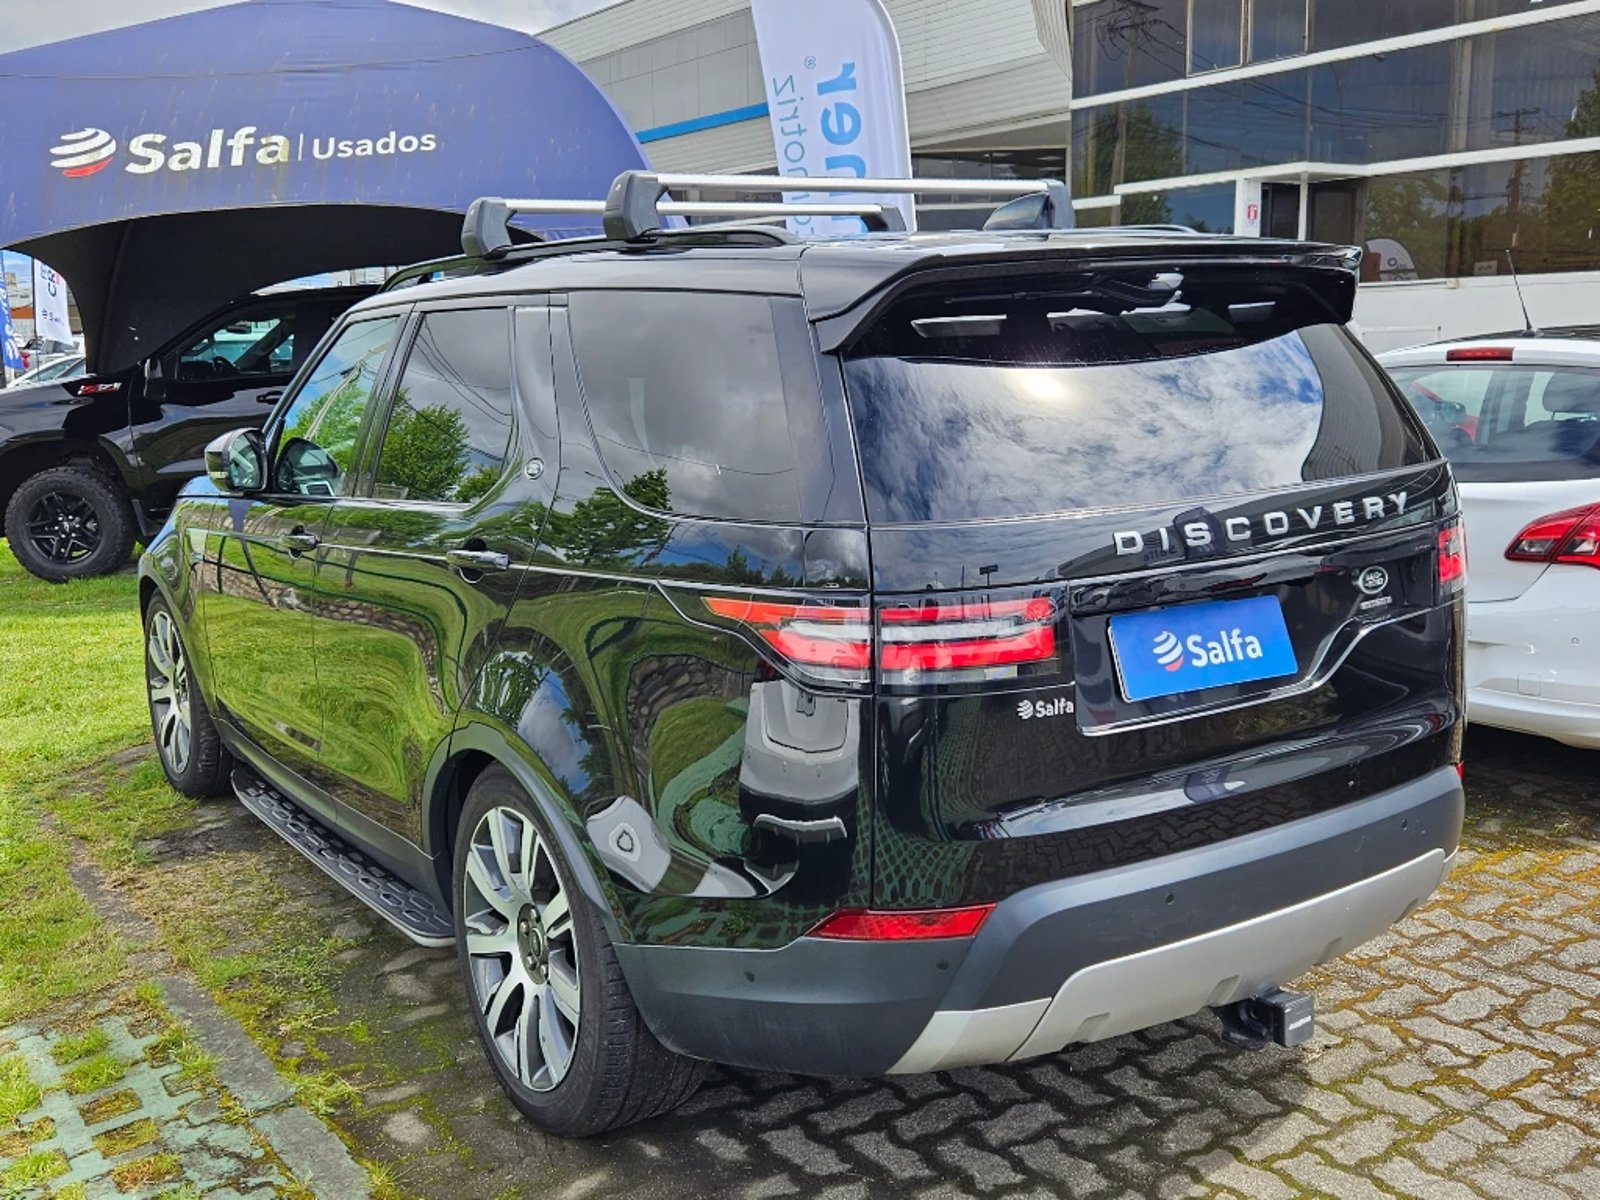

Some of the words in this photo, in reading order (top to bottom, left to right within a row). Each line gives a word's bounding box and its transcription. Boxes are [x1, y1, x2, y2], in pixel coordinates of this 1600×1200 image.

[124, 126, 290, 175] Salfa
[312, 131, 437, 161] Usados
[1113, 491, 1409, 556] DISCOVERY
[1187, 629, 1264, 668] Salfa
[1034, 697, 1075, 719] Salfa
